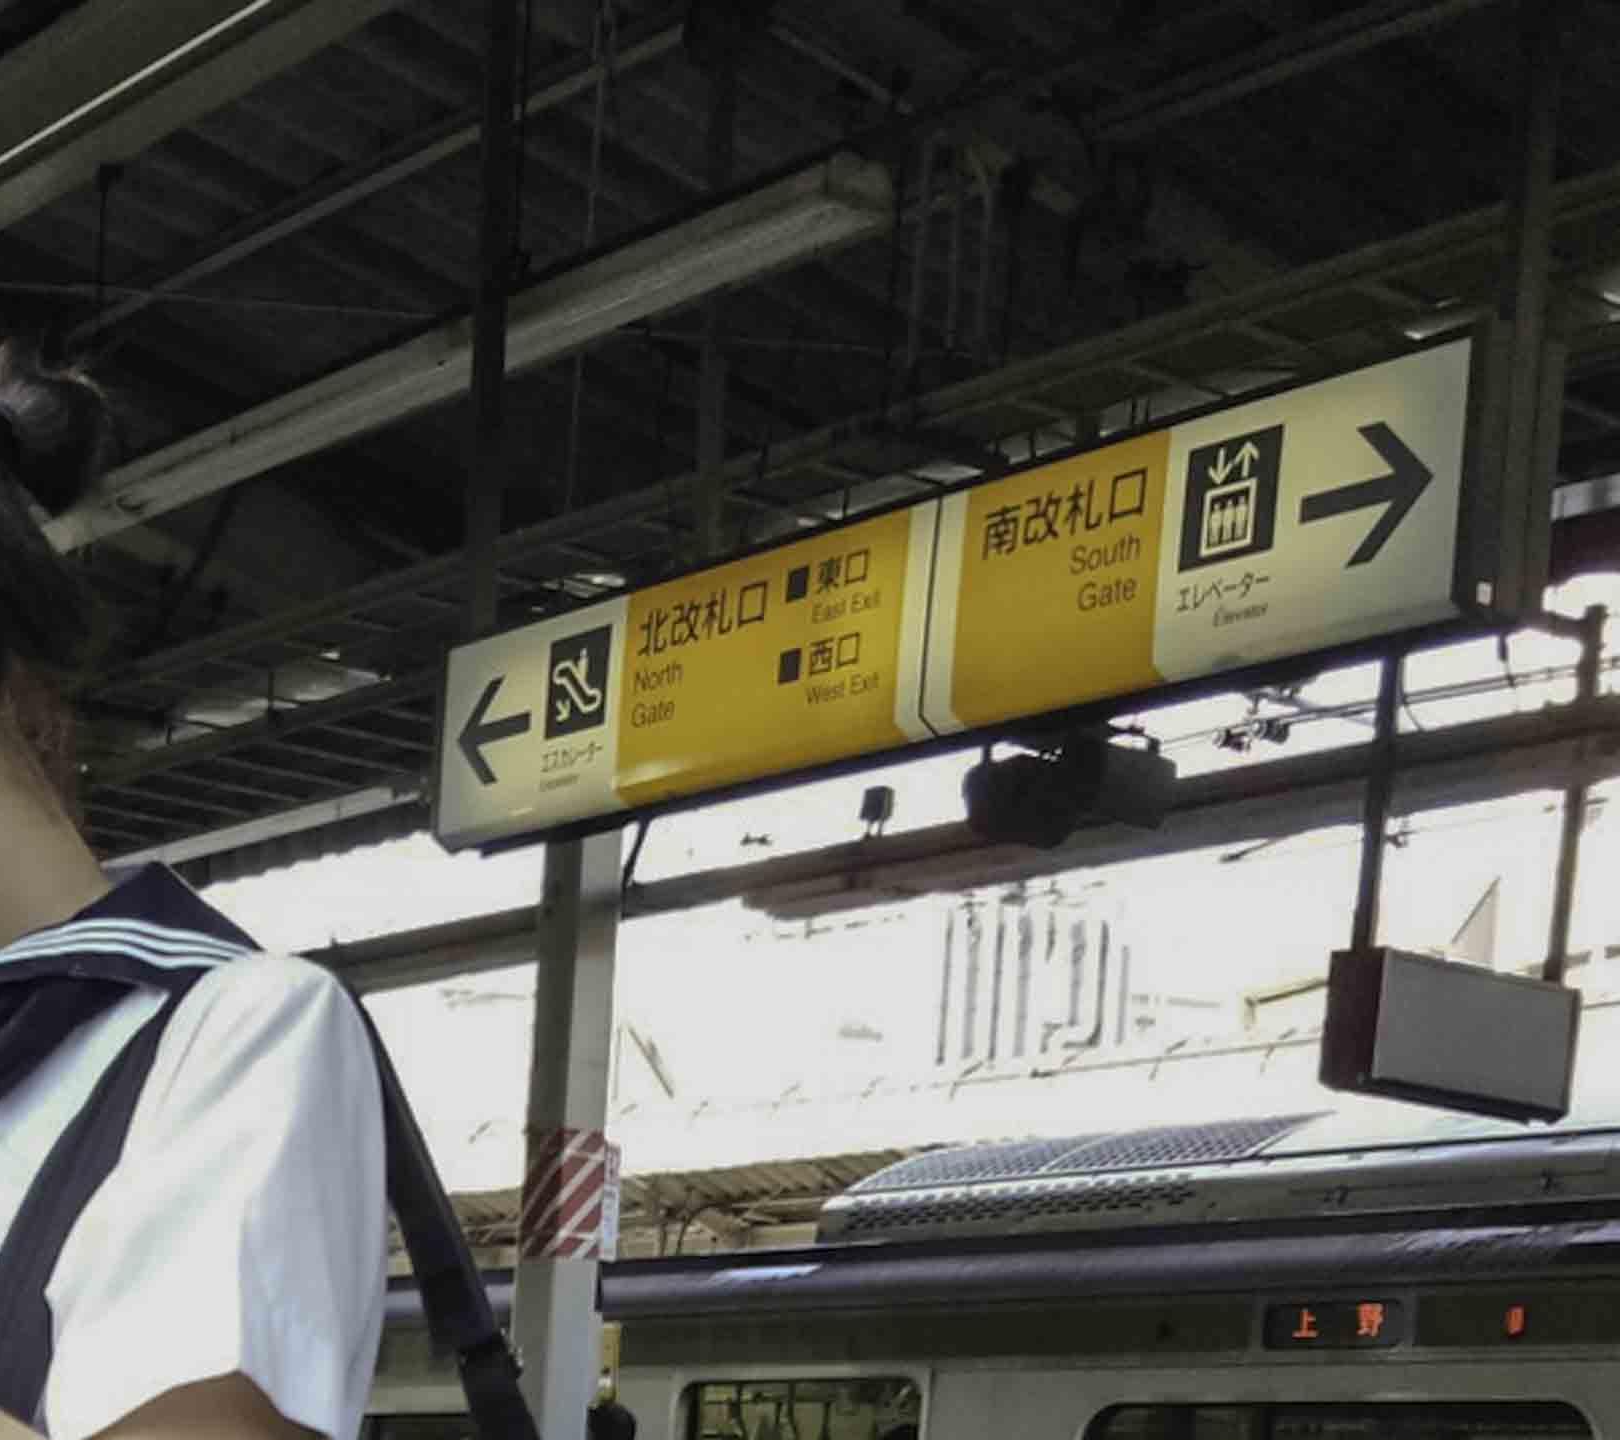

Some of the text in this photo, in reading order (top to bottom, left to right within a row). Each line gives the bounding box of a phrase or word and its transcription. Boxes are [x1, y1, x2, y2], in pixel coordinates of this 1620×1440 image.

[981, 467, 1148, 560] 南改札口
[815, 548, 870, 594] 東口
[1070, 533, 1141, 575] South
[1076, 576, 1138, 612] Gate
[1175, 571, 1272, 614] エレベーター
[637, 580, 768, 657] 北改札口
[808, 632, 861, 676] 西口
[632, 660, 684, 695] North
[630, 700, 676, 729] Gate
[1291, 1301, 1384, 1338] 上野
